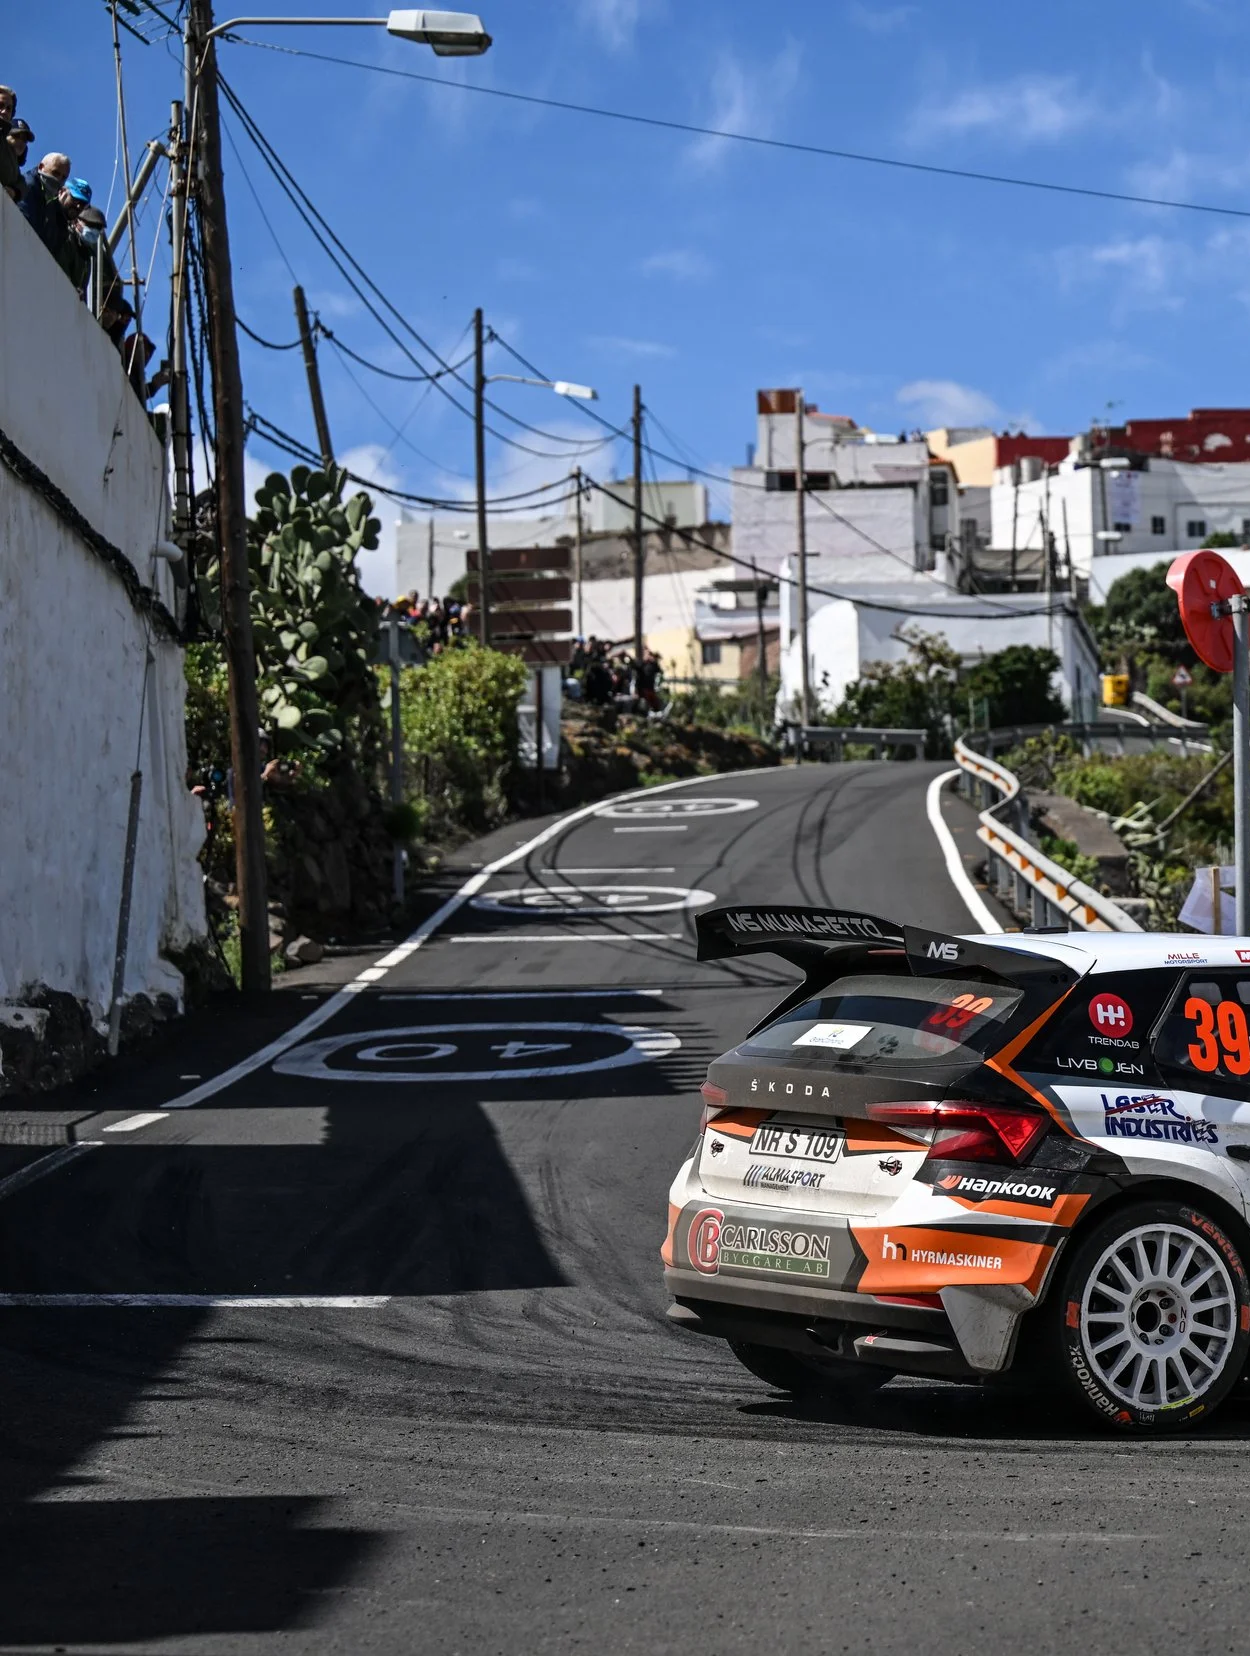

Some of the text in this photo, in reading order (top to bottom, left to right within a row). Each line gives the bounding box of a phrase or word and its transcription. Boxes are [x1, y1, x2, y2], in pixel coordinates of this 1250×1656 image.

[726, 912, 884, 938] MS MUNARETTO
[927, 941, 959, 960] MS
[1167, 952, 1200, 960] MILLE
[929, 993, 994, 1028] 39
[356, 1041, 572, 1061] 40
[751, 1078, 830, 1098] ŠKODA
[1100, 1093, 1186, 1121] LASER
[1105, 1116, 1219, 1144] INDUSTRIES
[754, 1126, 839, 1159] NR S 109
[761, 1166, 826, 1188] ALMASPORT
[721, 1224, 831, 1259] CARLSSON
[723, 1252, 823, 1274] BYGGARE AB
[911, 1249, 1002, 1269] HYRMASKINER
